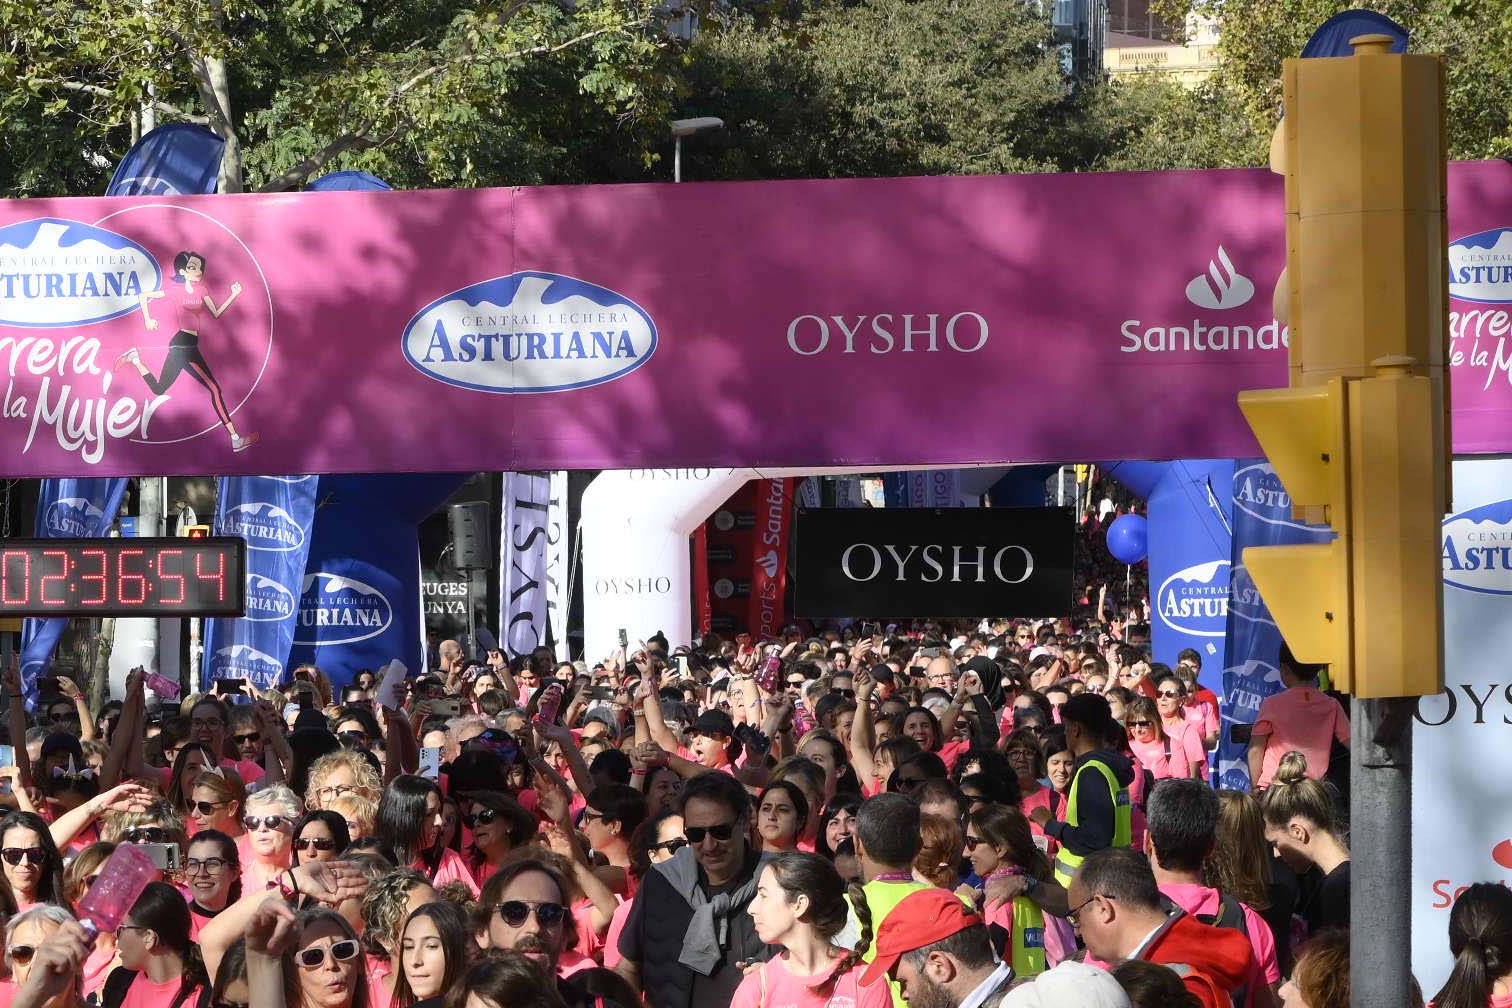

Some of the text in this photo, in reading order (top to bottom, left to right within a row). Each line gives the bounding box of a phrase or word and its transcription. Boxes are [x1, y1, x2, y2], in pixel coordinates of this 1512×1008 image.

[64, 254, 138, 266] LECHERA
[422, 319, 638, 363] ASTURIANA
[462, 312, 629, 328] CENTRAL LECHERA
[787, 311, 989, 355] OYSHO
[3, 379, 28, 419] la
[22, 370, 174, 465] Mujer
[2, 550, 225, 604] 02:36:54
[842, 543, 1034, 584] OYSHO
[595, 576, 672, 596] OYSHO
